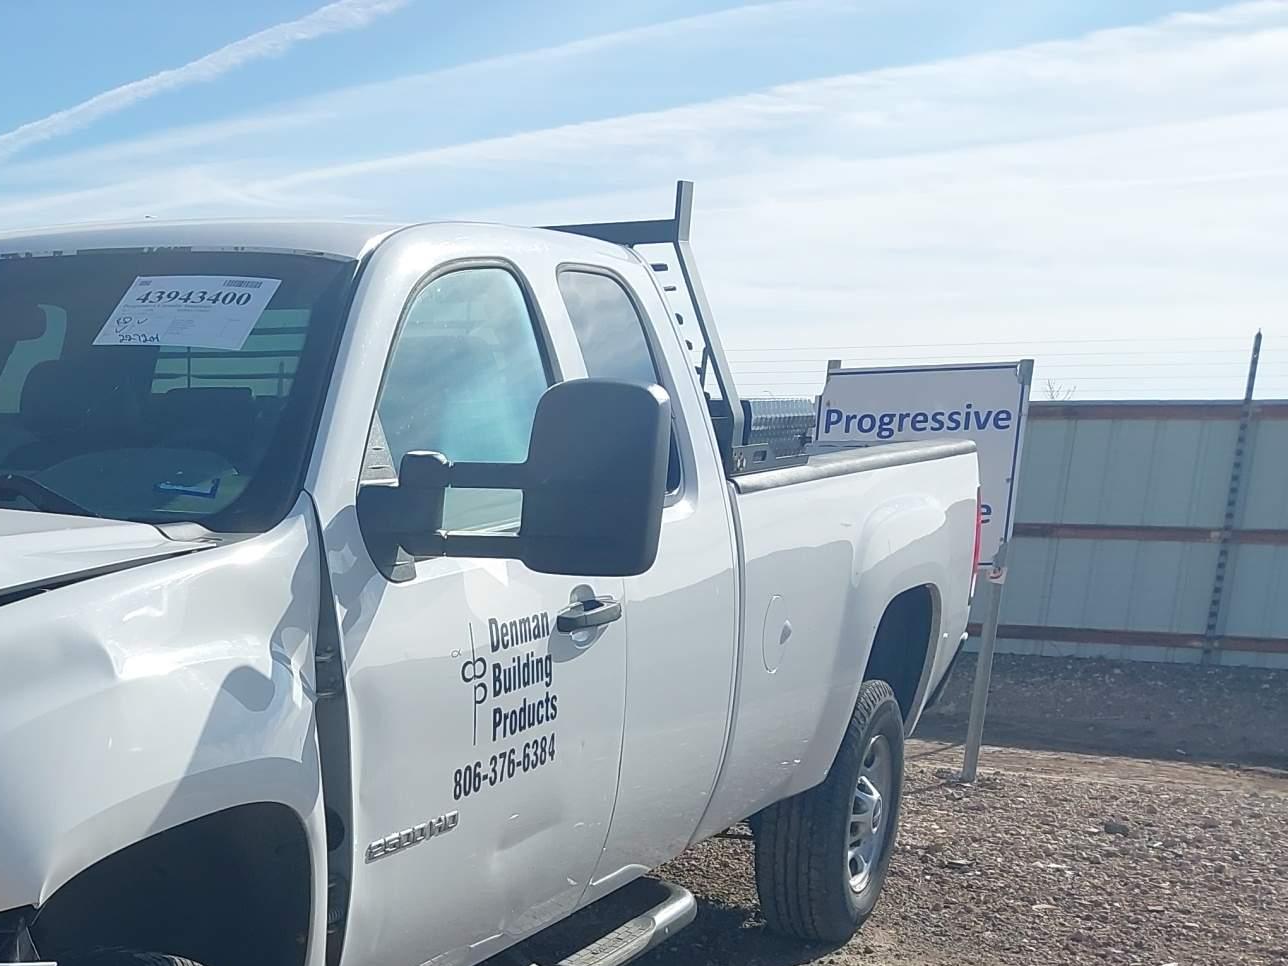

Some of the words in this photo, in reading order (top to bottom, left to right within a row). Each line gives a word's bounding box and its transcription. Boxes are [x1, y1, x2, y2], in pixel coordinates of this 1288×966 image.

[136, 291, 252, 306] 43943400
[824, 403, 1012, 439] Progressive
[488, 611, 551, 653] Denman
[492, 651, 553, 698] Building
[492, 691, 558, 742] Products
[452, 732, 556, 801] 806-376-6384
